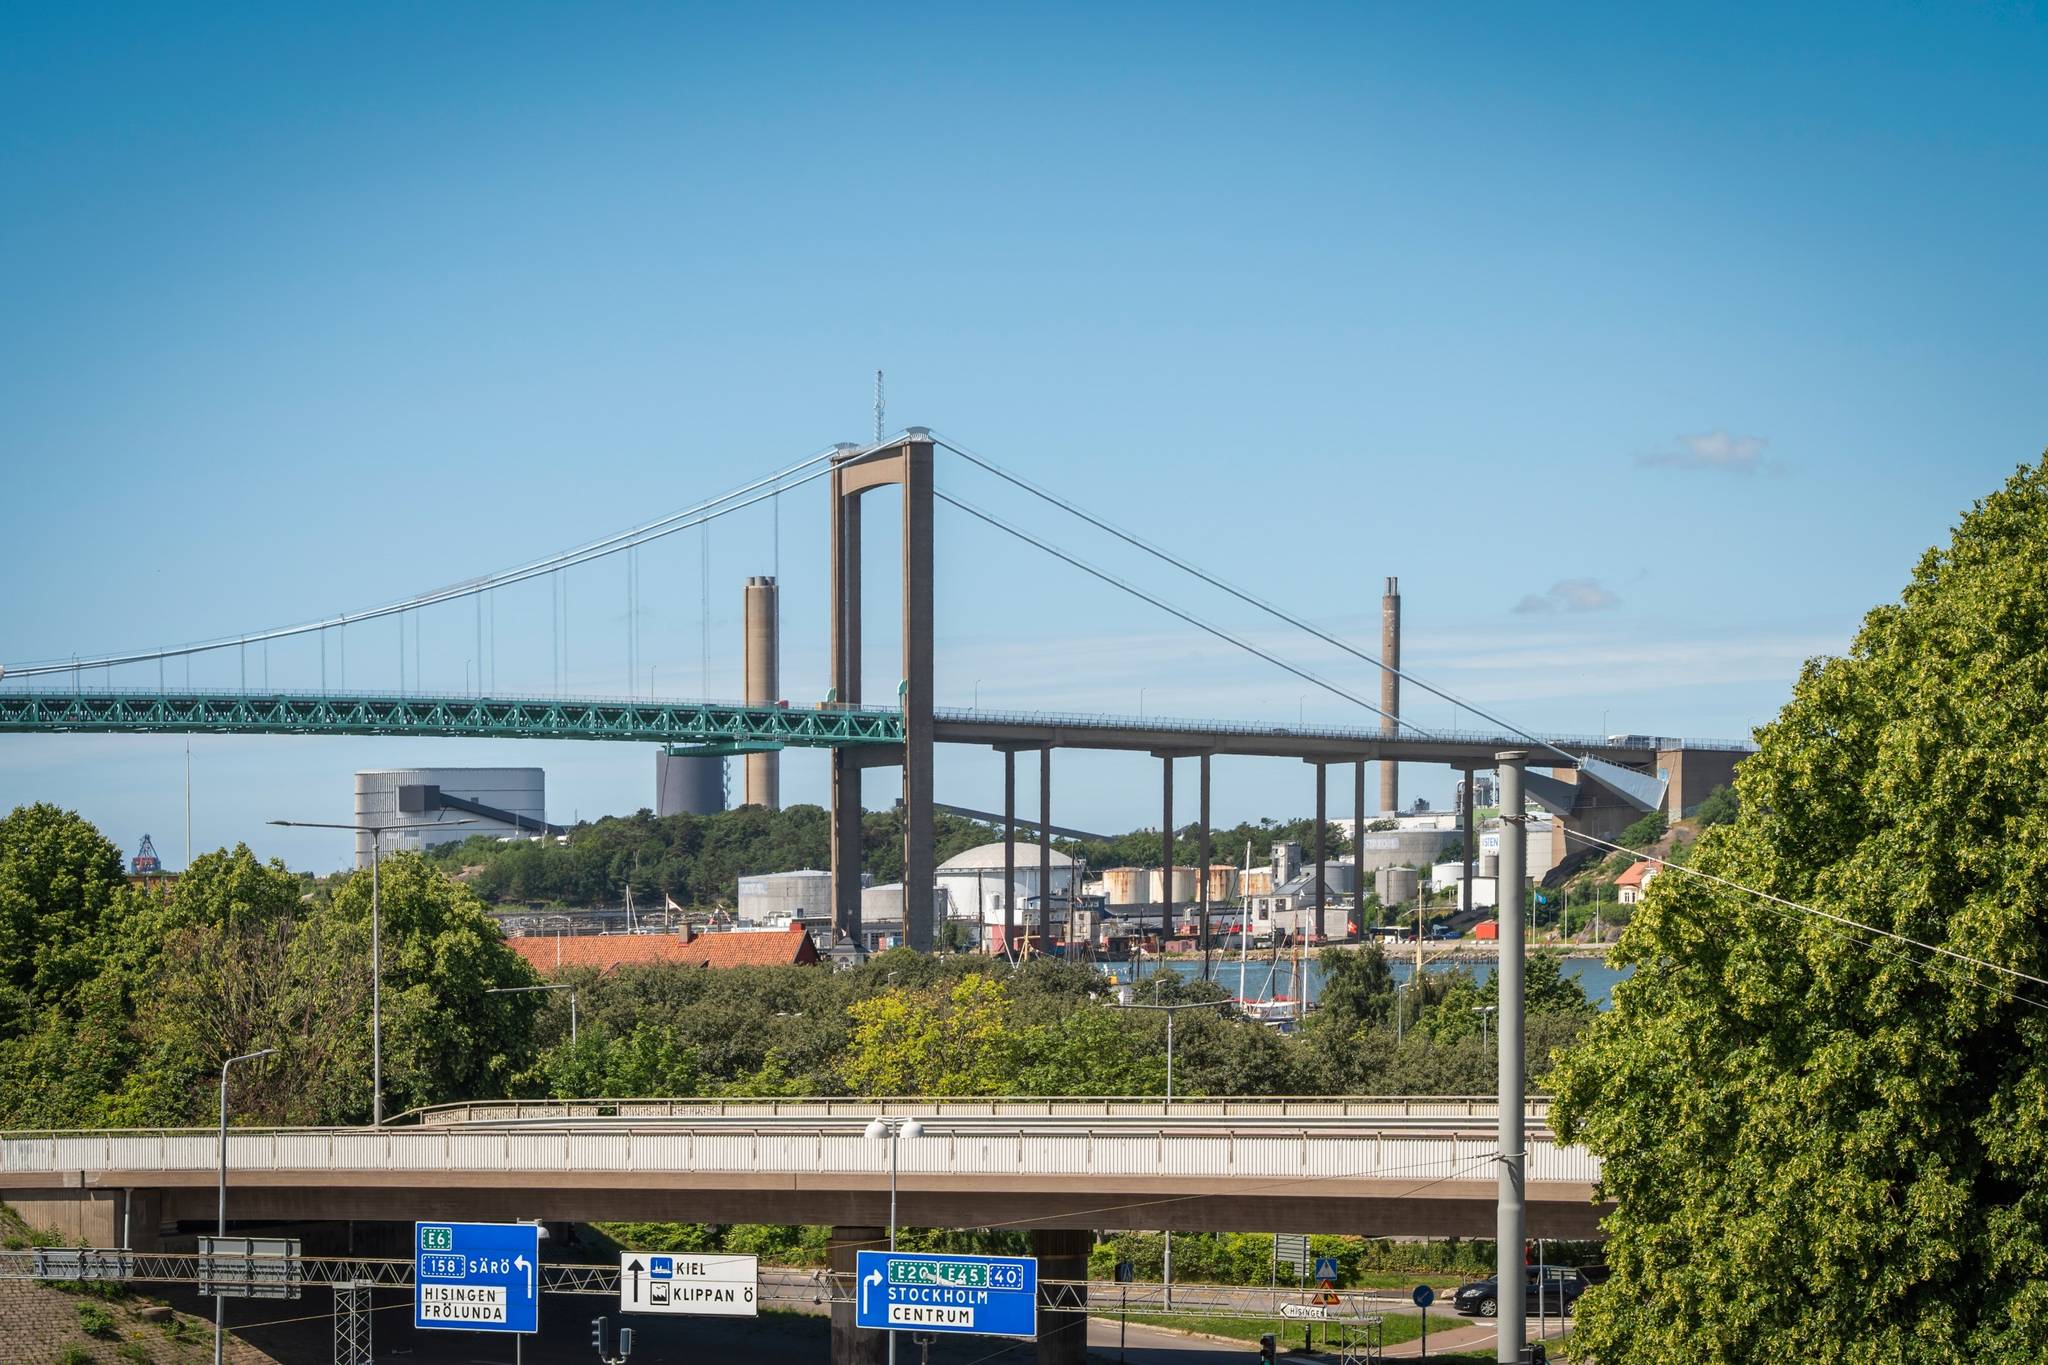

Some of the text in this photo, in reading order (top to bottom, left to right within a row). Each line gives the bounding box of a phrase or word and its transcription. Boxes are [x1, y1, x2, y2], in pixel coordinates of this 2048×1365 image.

[428, 1232, 445, 1246] E6
[431, 1258, 510, 1274] 158 SÄRÖ
[676, 1262, 706, 1276] KIEL
[897, 1265, 1017, 1284] E20 E45 40
[424, 1287, 496, 1303] HISINGEN
[673, 1286, 754, 1303] KLIPPAN Ö
[888, 1287, 988, 1305] STOCKHOLM
[424, 1303, 503, 1320] FRÖLUNDA
[893, 1307, 970, 1323] CENTRUM
